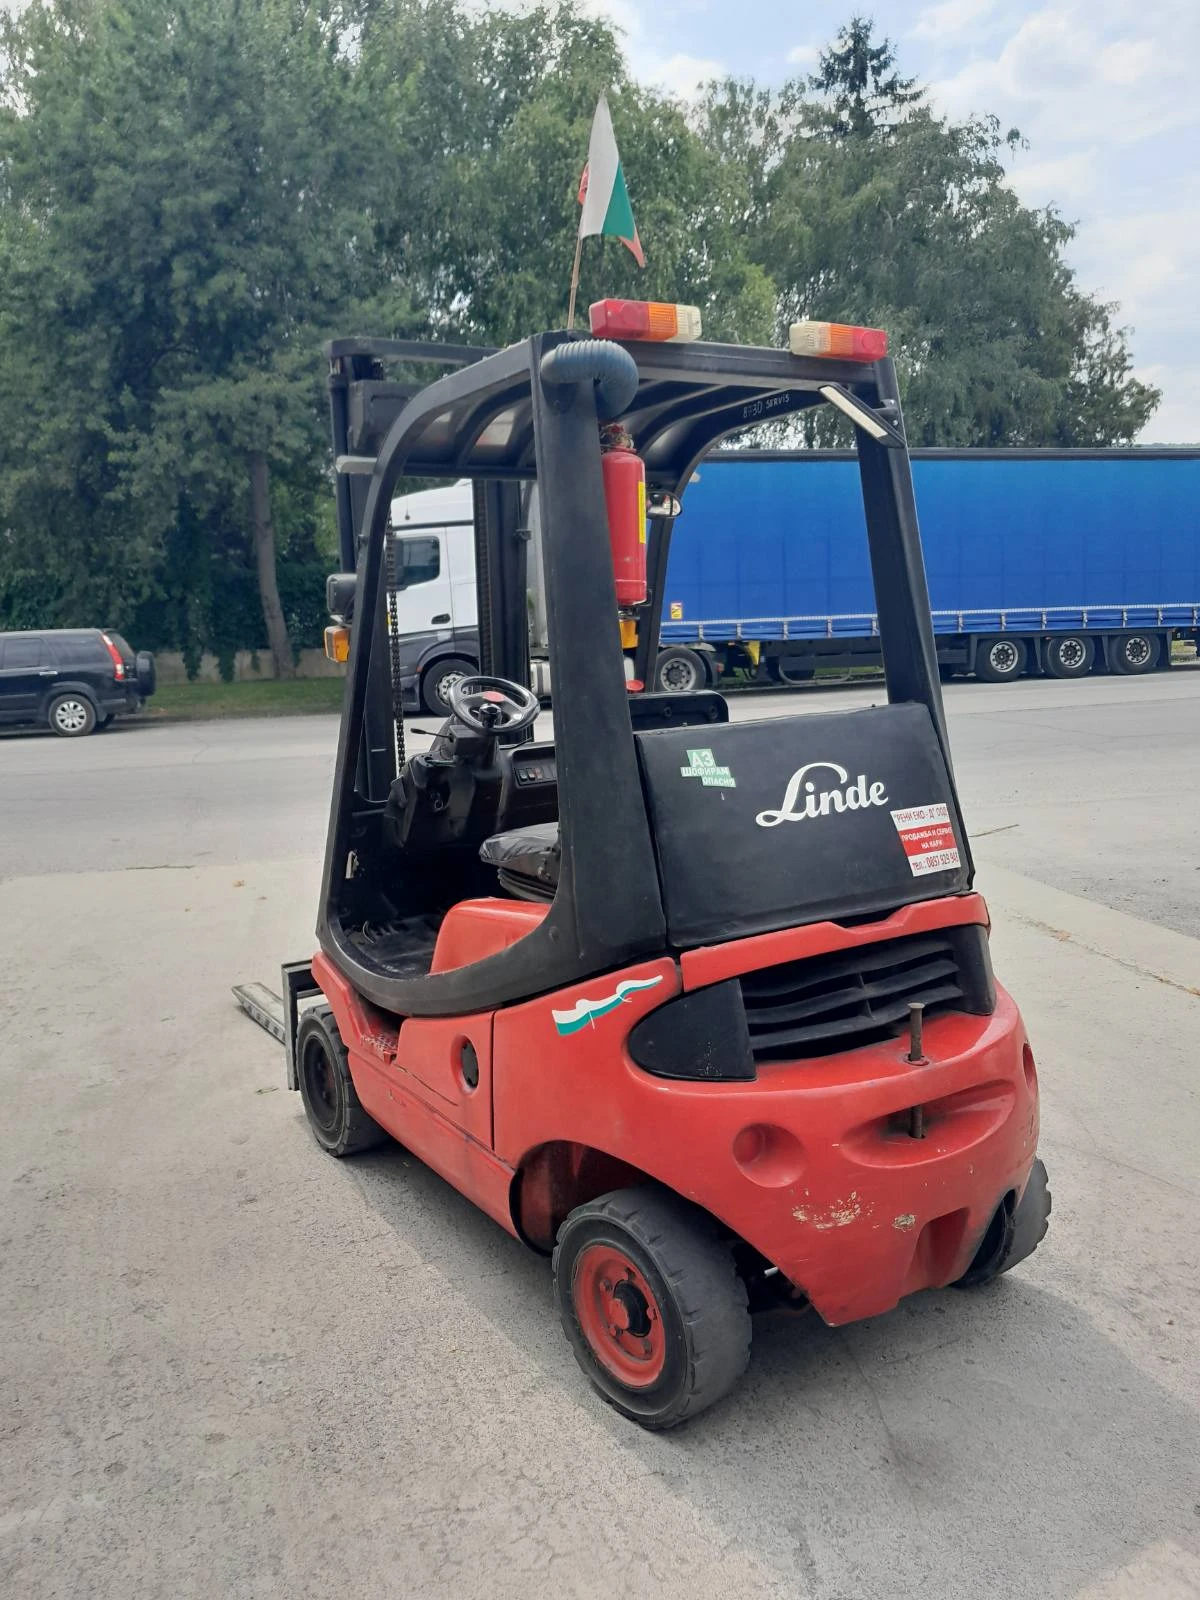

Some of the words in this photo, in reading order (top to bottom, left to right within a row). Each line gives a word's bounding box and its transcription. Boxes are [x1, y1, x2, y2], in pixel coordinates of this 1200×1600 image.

[682, 767, 729, 777] ШОФИРАМ
[702, 776, 735, 786] ОПАСНО
[755, 762, 889, 827] Linde
[901, 830, 932, 842] ПРОДАЖБА
